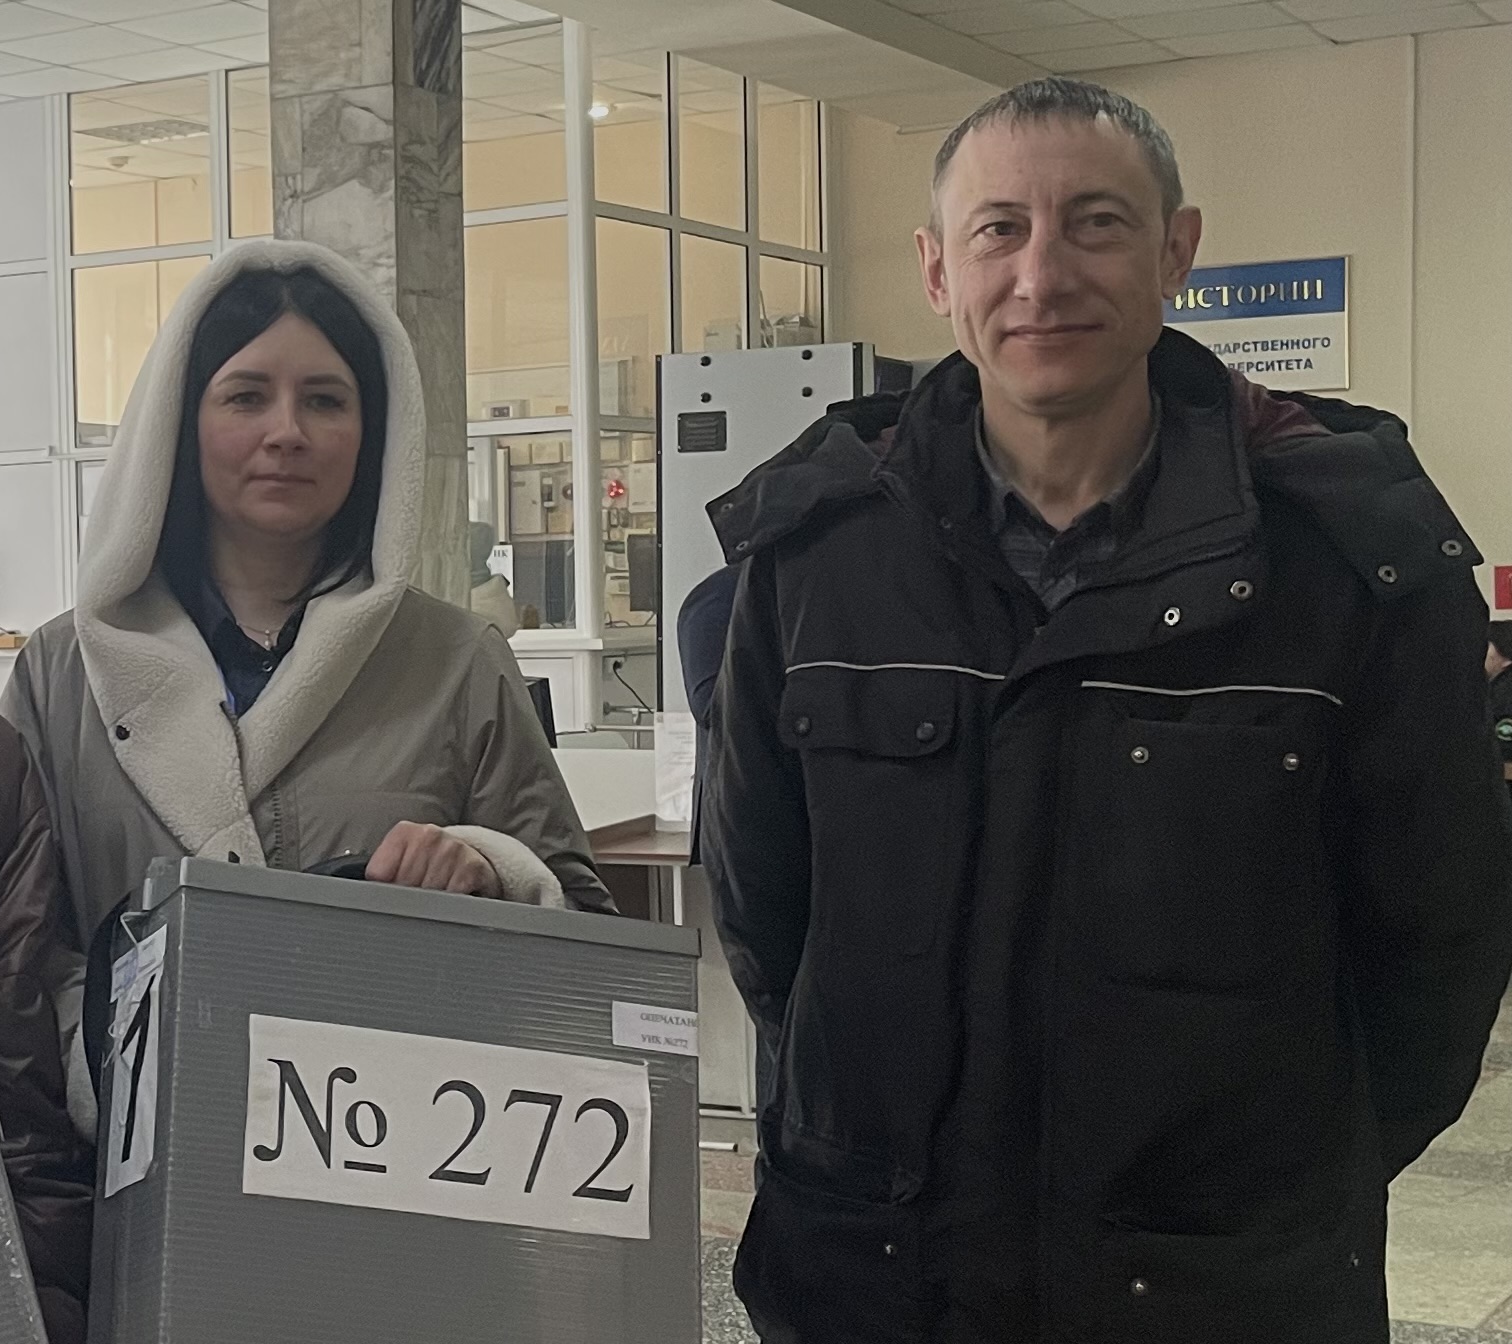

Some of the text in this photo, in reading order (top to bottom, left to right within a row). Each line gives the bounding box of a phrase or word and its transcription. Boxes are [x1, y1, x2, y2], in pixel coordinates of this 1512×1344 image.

[1174, 279, 1324, 310] ИСТОРИИ
[1208, 337, 1331, 356] ДАРСТВЕННОГО
[253, 1058, 635, 1203] № 272
